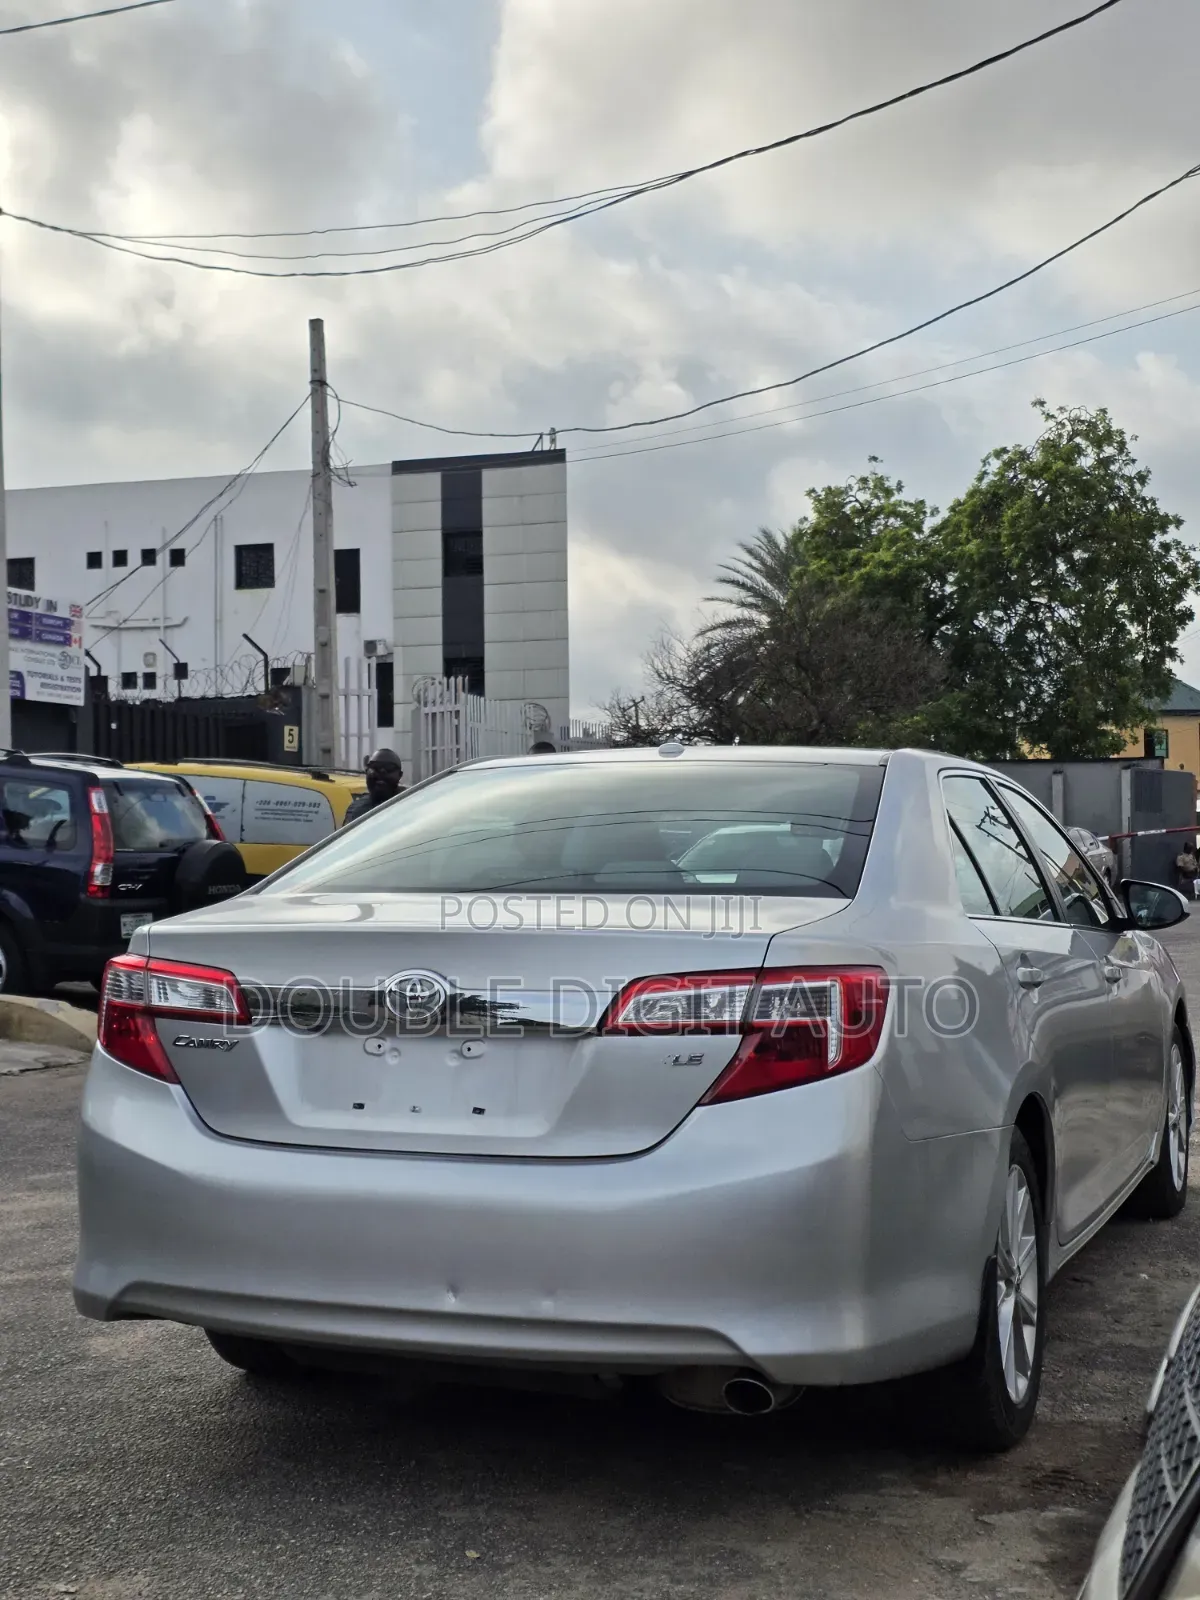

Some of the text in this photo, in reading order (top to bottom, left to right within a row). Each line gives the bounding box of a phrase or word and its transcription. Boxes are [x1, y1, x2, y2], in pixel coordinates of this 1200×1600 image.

[7, 591, 58, 613] STUDY IN
[287, 728, 295, 744] 5
[207, 884, 242, 895] HONDA
[172, 1034, 240, 1052] CAMRY
